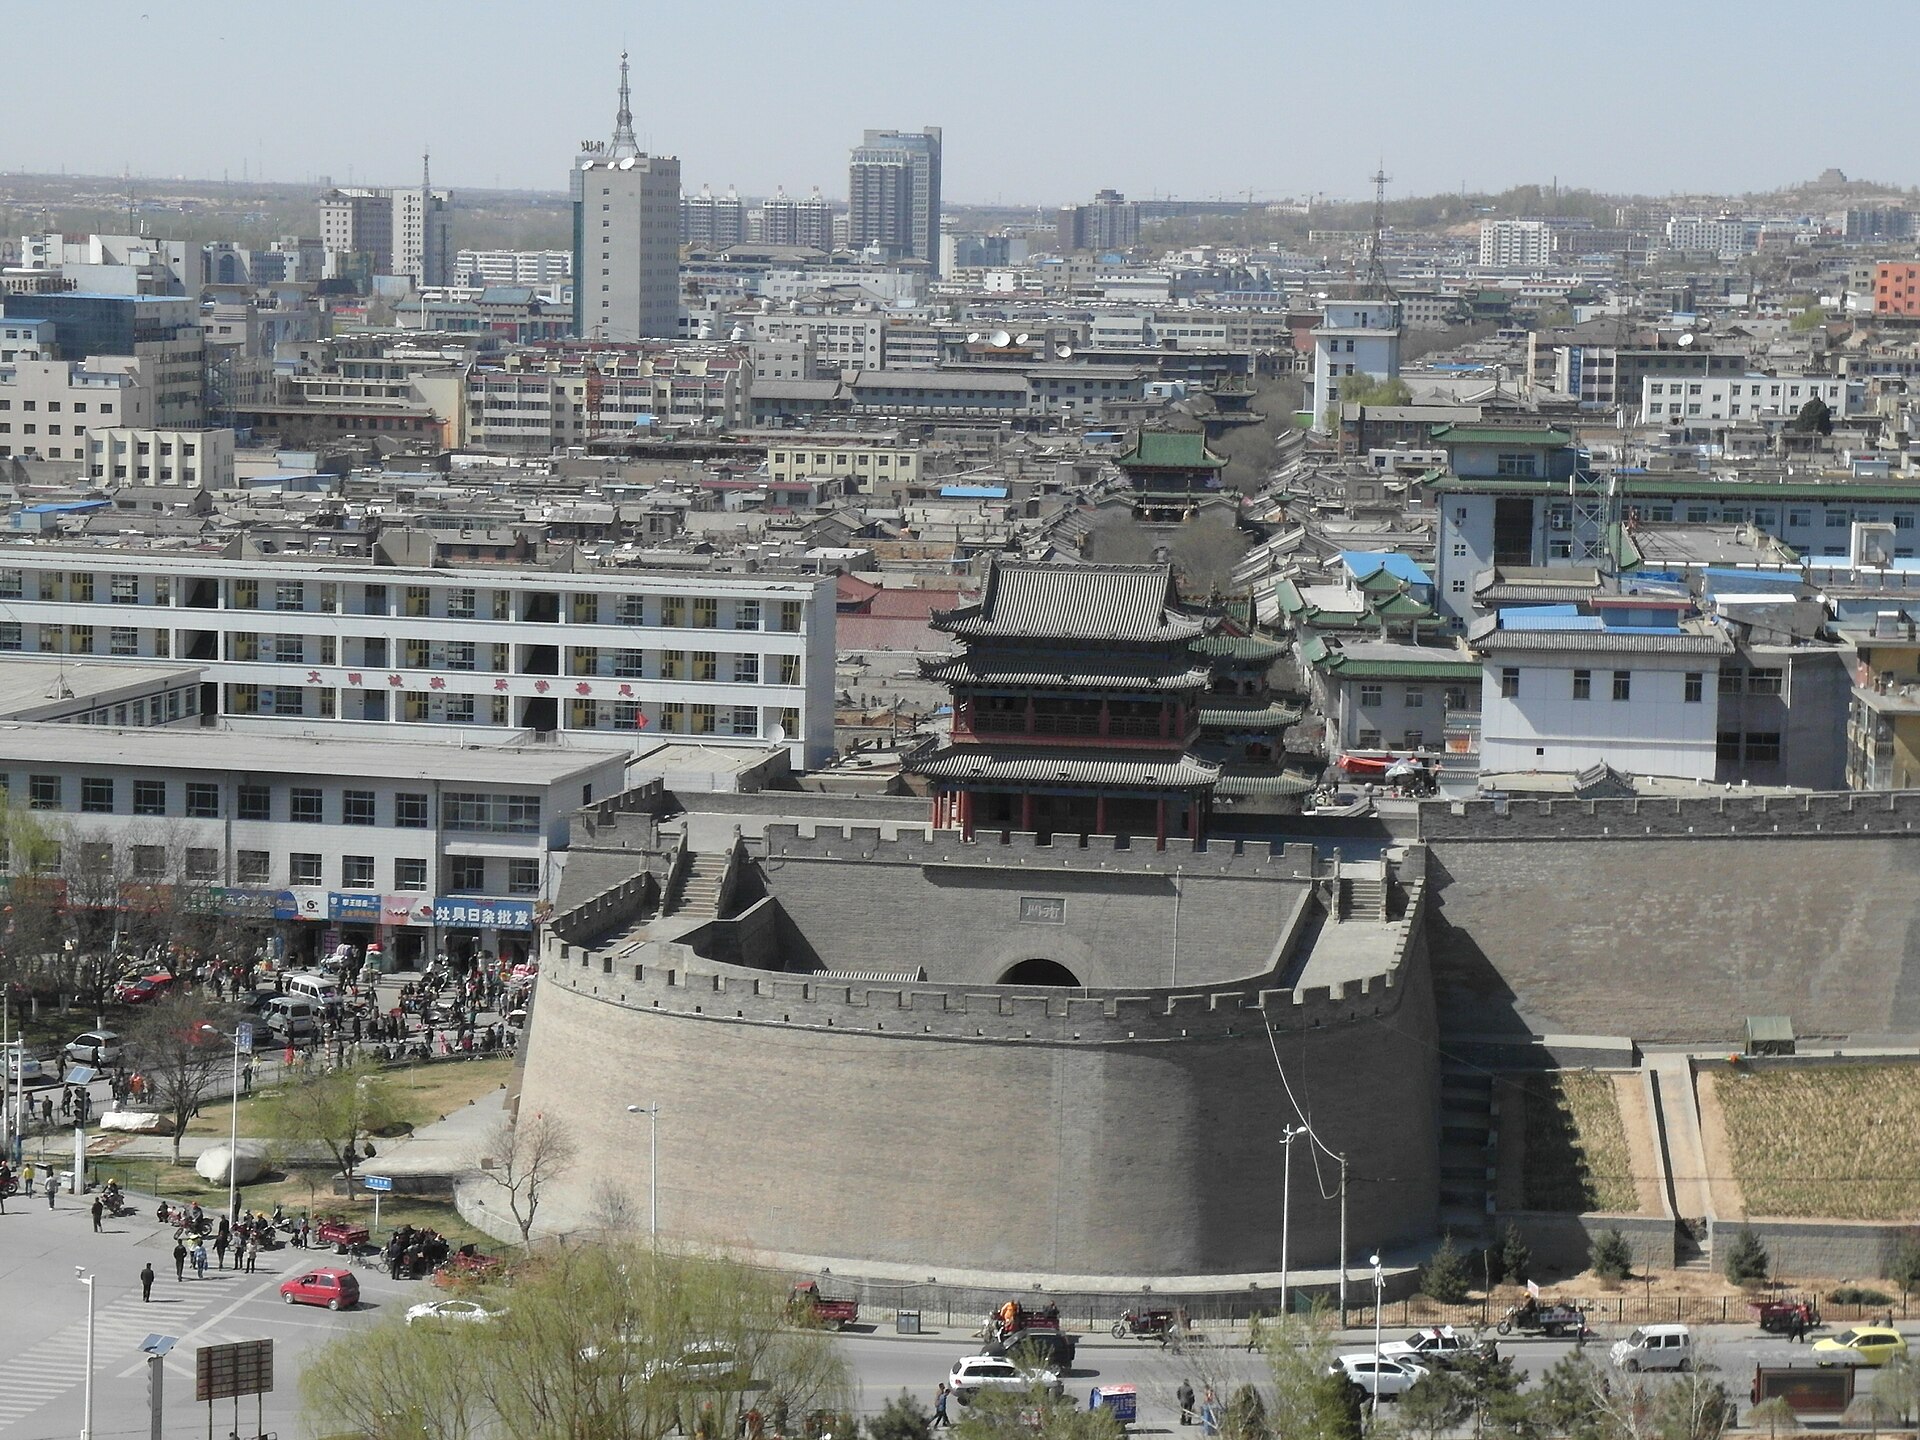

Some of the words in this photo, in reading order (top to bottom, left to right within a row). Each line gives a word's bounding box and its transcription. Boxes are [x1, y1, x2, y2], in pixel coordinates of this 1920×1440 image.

[436, 906, 529, 925] 灶具日杂批发
